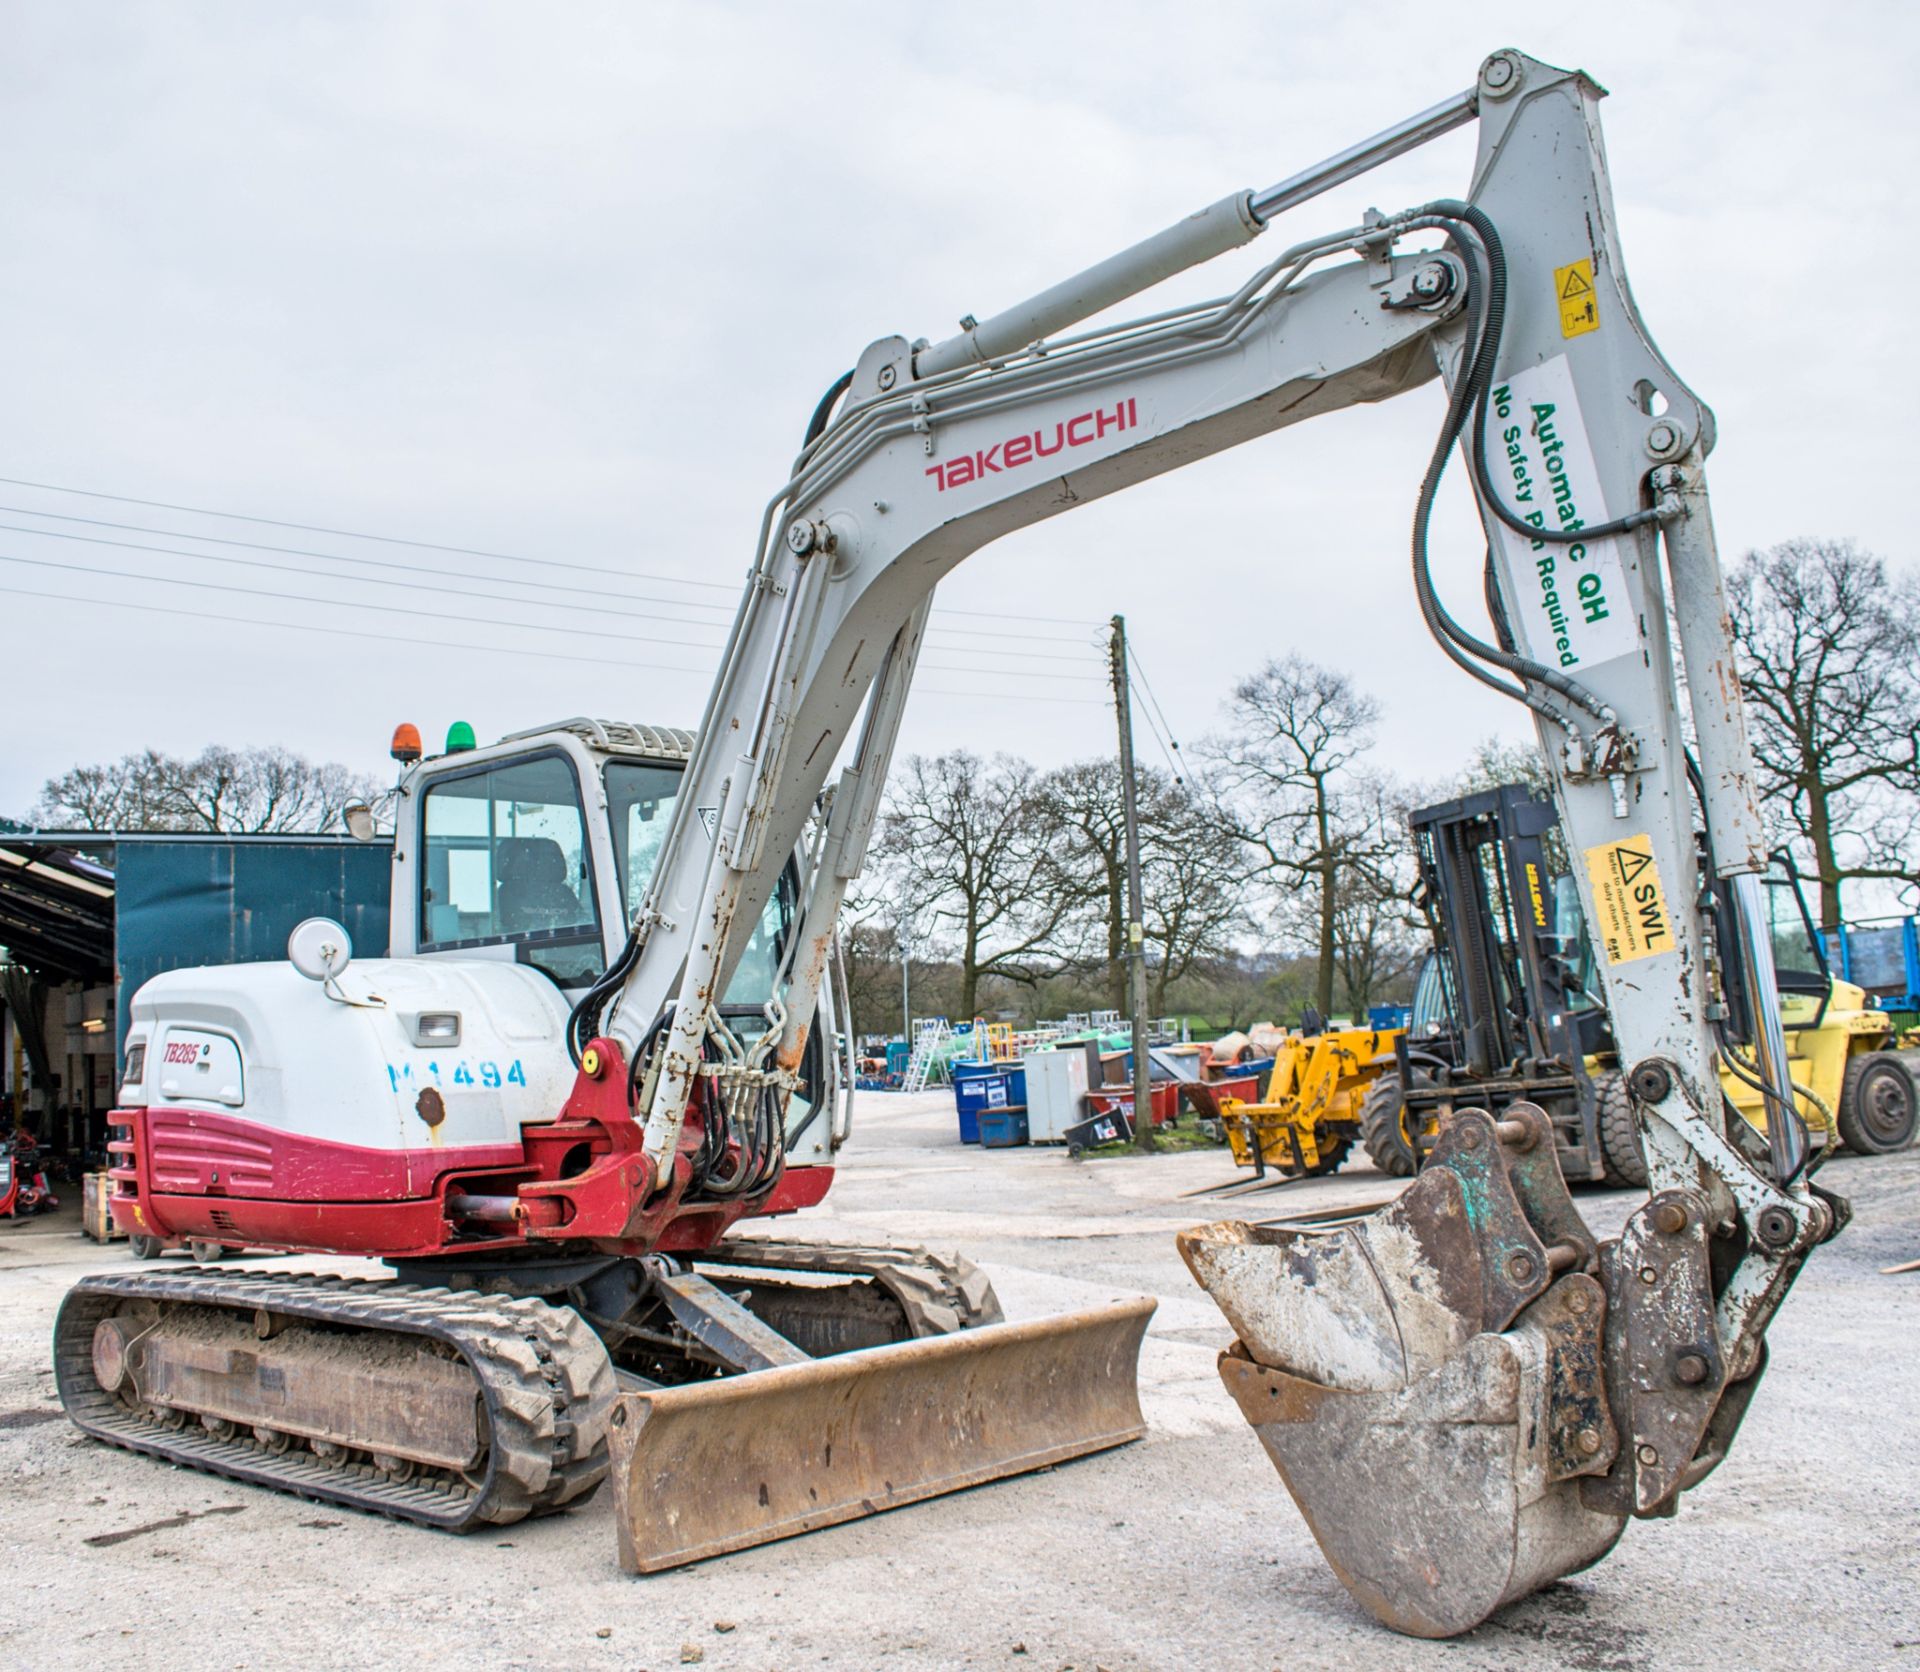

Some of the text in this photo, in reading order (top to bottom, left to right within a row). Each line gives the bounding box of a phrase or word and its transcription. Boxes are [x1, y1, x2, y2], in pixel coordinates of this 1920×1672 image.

[1492, 385, 1580, 667] No Safety Pn Required
[1531, 403, 1610, 624] Automatc QH
[1526, 863, 1547, 927] HYSTER
[1603, 882, 1620, 932] duty charts
[1608, 851, 1637, 952] Refer to manufacturers
[1634, 884, 1666, 950] SWL
[163, 1043, 200, 1065] TB285
